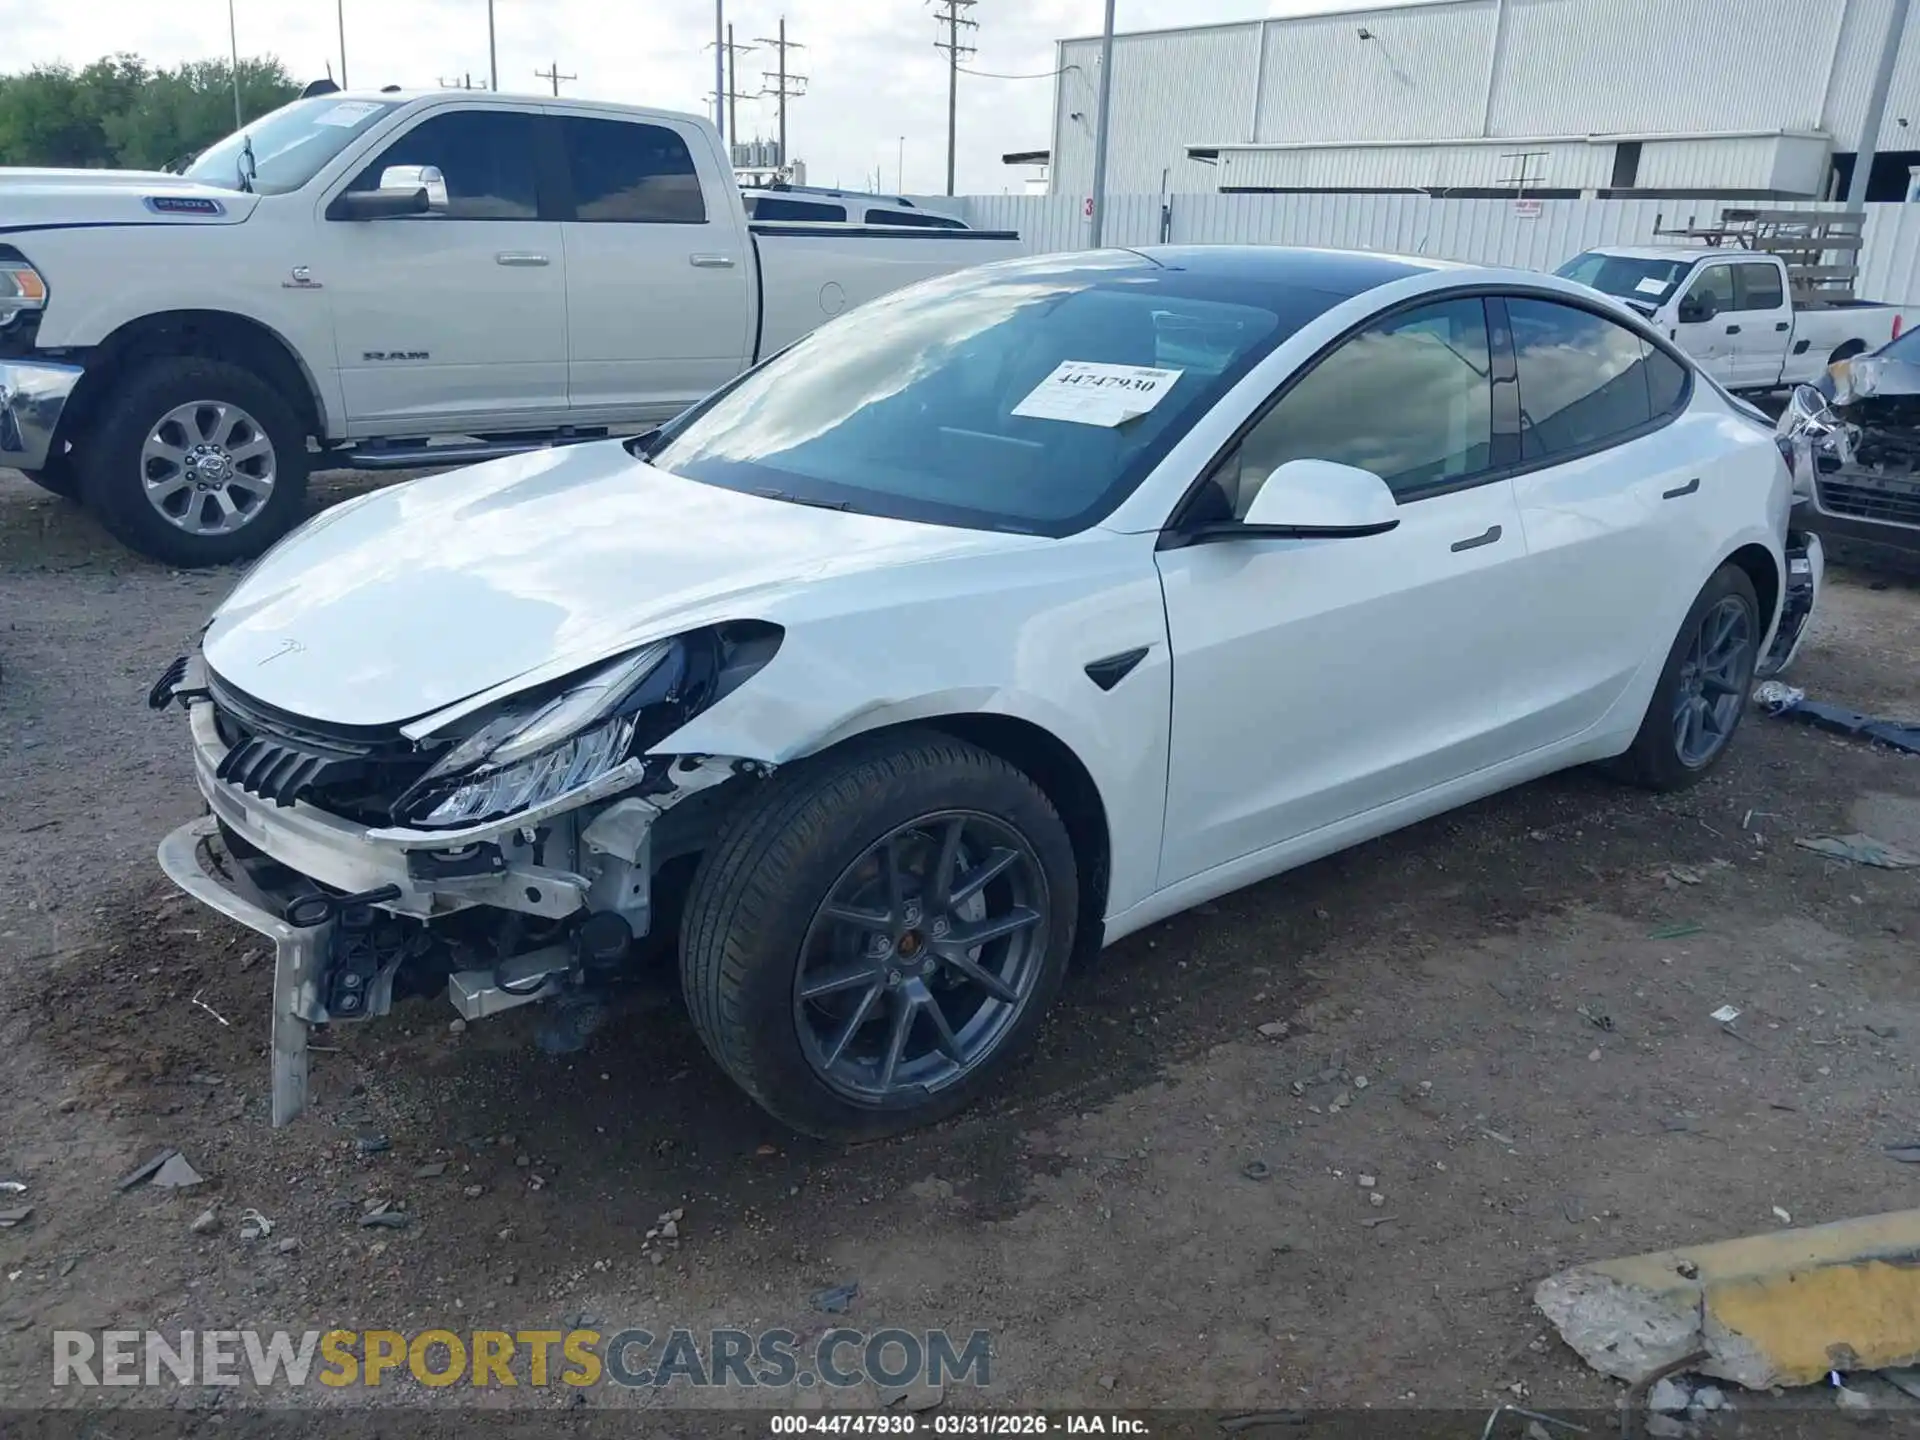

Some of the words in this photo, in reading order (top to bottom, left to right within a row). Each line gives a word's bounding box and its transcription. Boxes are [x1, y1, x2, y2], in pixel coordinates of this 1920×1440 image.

[1086, 198, 1094, 216] 3
[363, 351, 430, 361] RAM
[1057, 373, 1157, 392] 44747930
